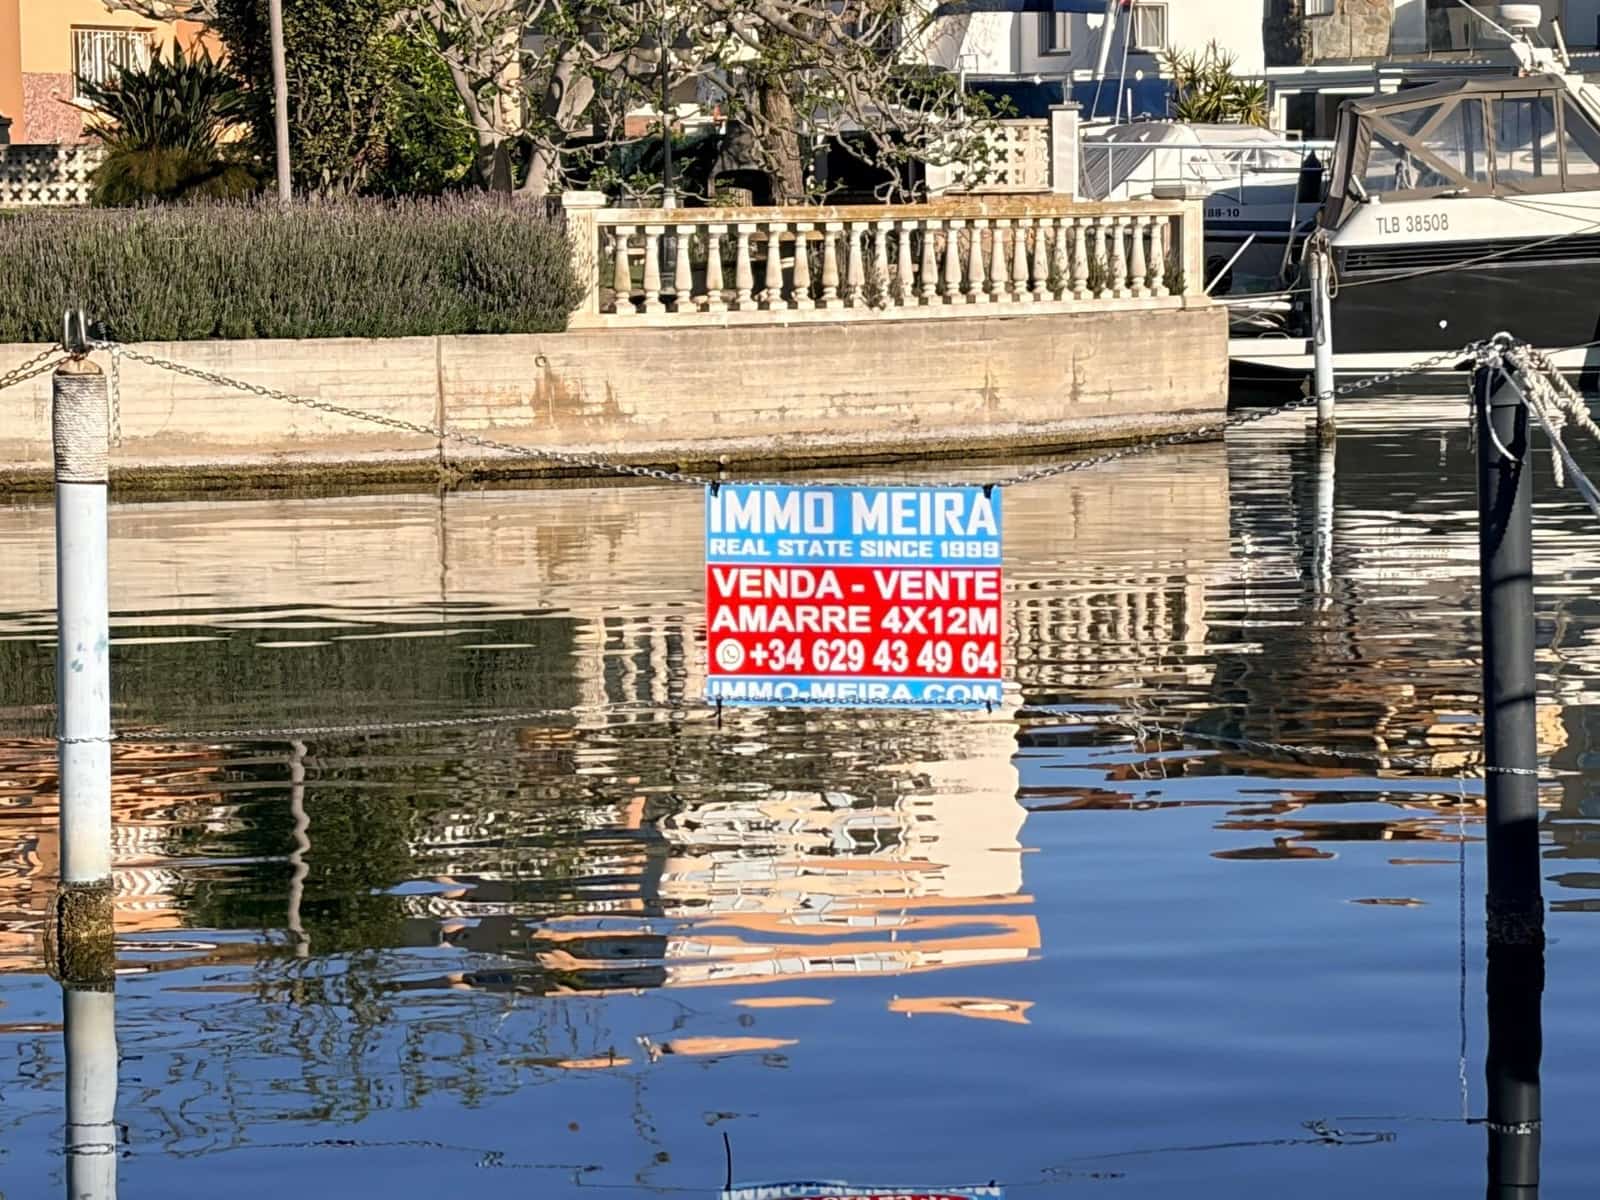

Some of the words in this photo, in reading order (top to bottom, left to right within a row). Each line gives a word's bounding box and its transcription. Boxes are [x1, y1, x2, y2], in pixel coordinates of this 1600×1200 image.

[1375, 216, 1401, 235] TLB
[1406, 213, 1449, 232] 38508
[709, 490, 834, 535] IMMO
[852, 491, 998, 536] MEIRA
[709, 538, 771, 556] REAL
[777, 539, 853, 557] STATE
[860, 540, 934, 558] SINCE
[940, 541, 999, 558] 1999
[711, 568, 844, 599] VENDA
[873, 570, 998, 600] VENTE
[711, 605, 872, 633] AMARRE
[881, 606, 998, 635] 4X12M
[750, 639, 804, 671] +34
[811, 639, 864, 672] 629
[872, 640, 909, 672] 43
[916, 640, 953, 673] 49
[961, 641, 998, 674] 64
[712, 681, 998, 701] IMMO-MEIRACOM
